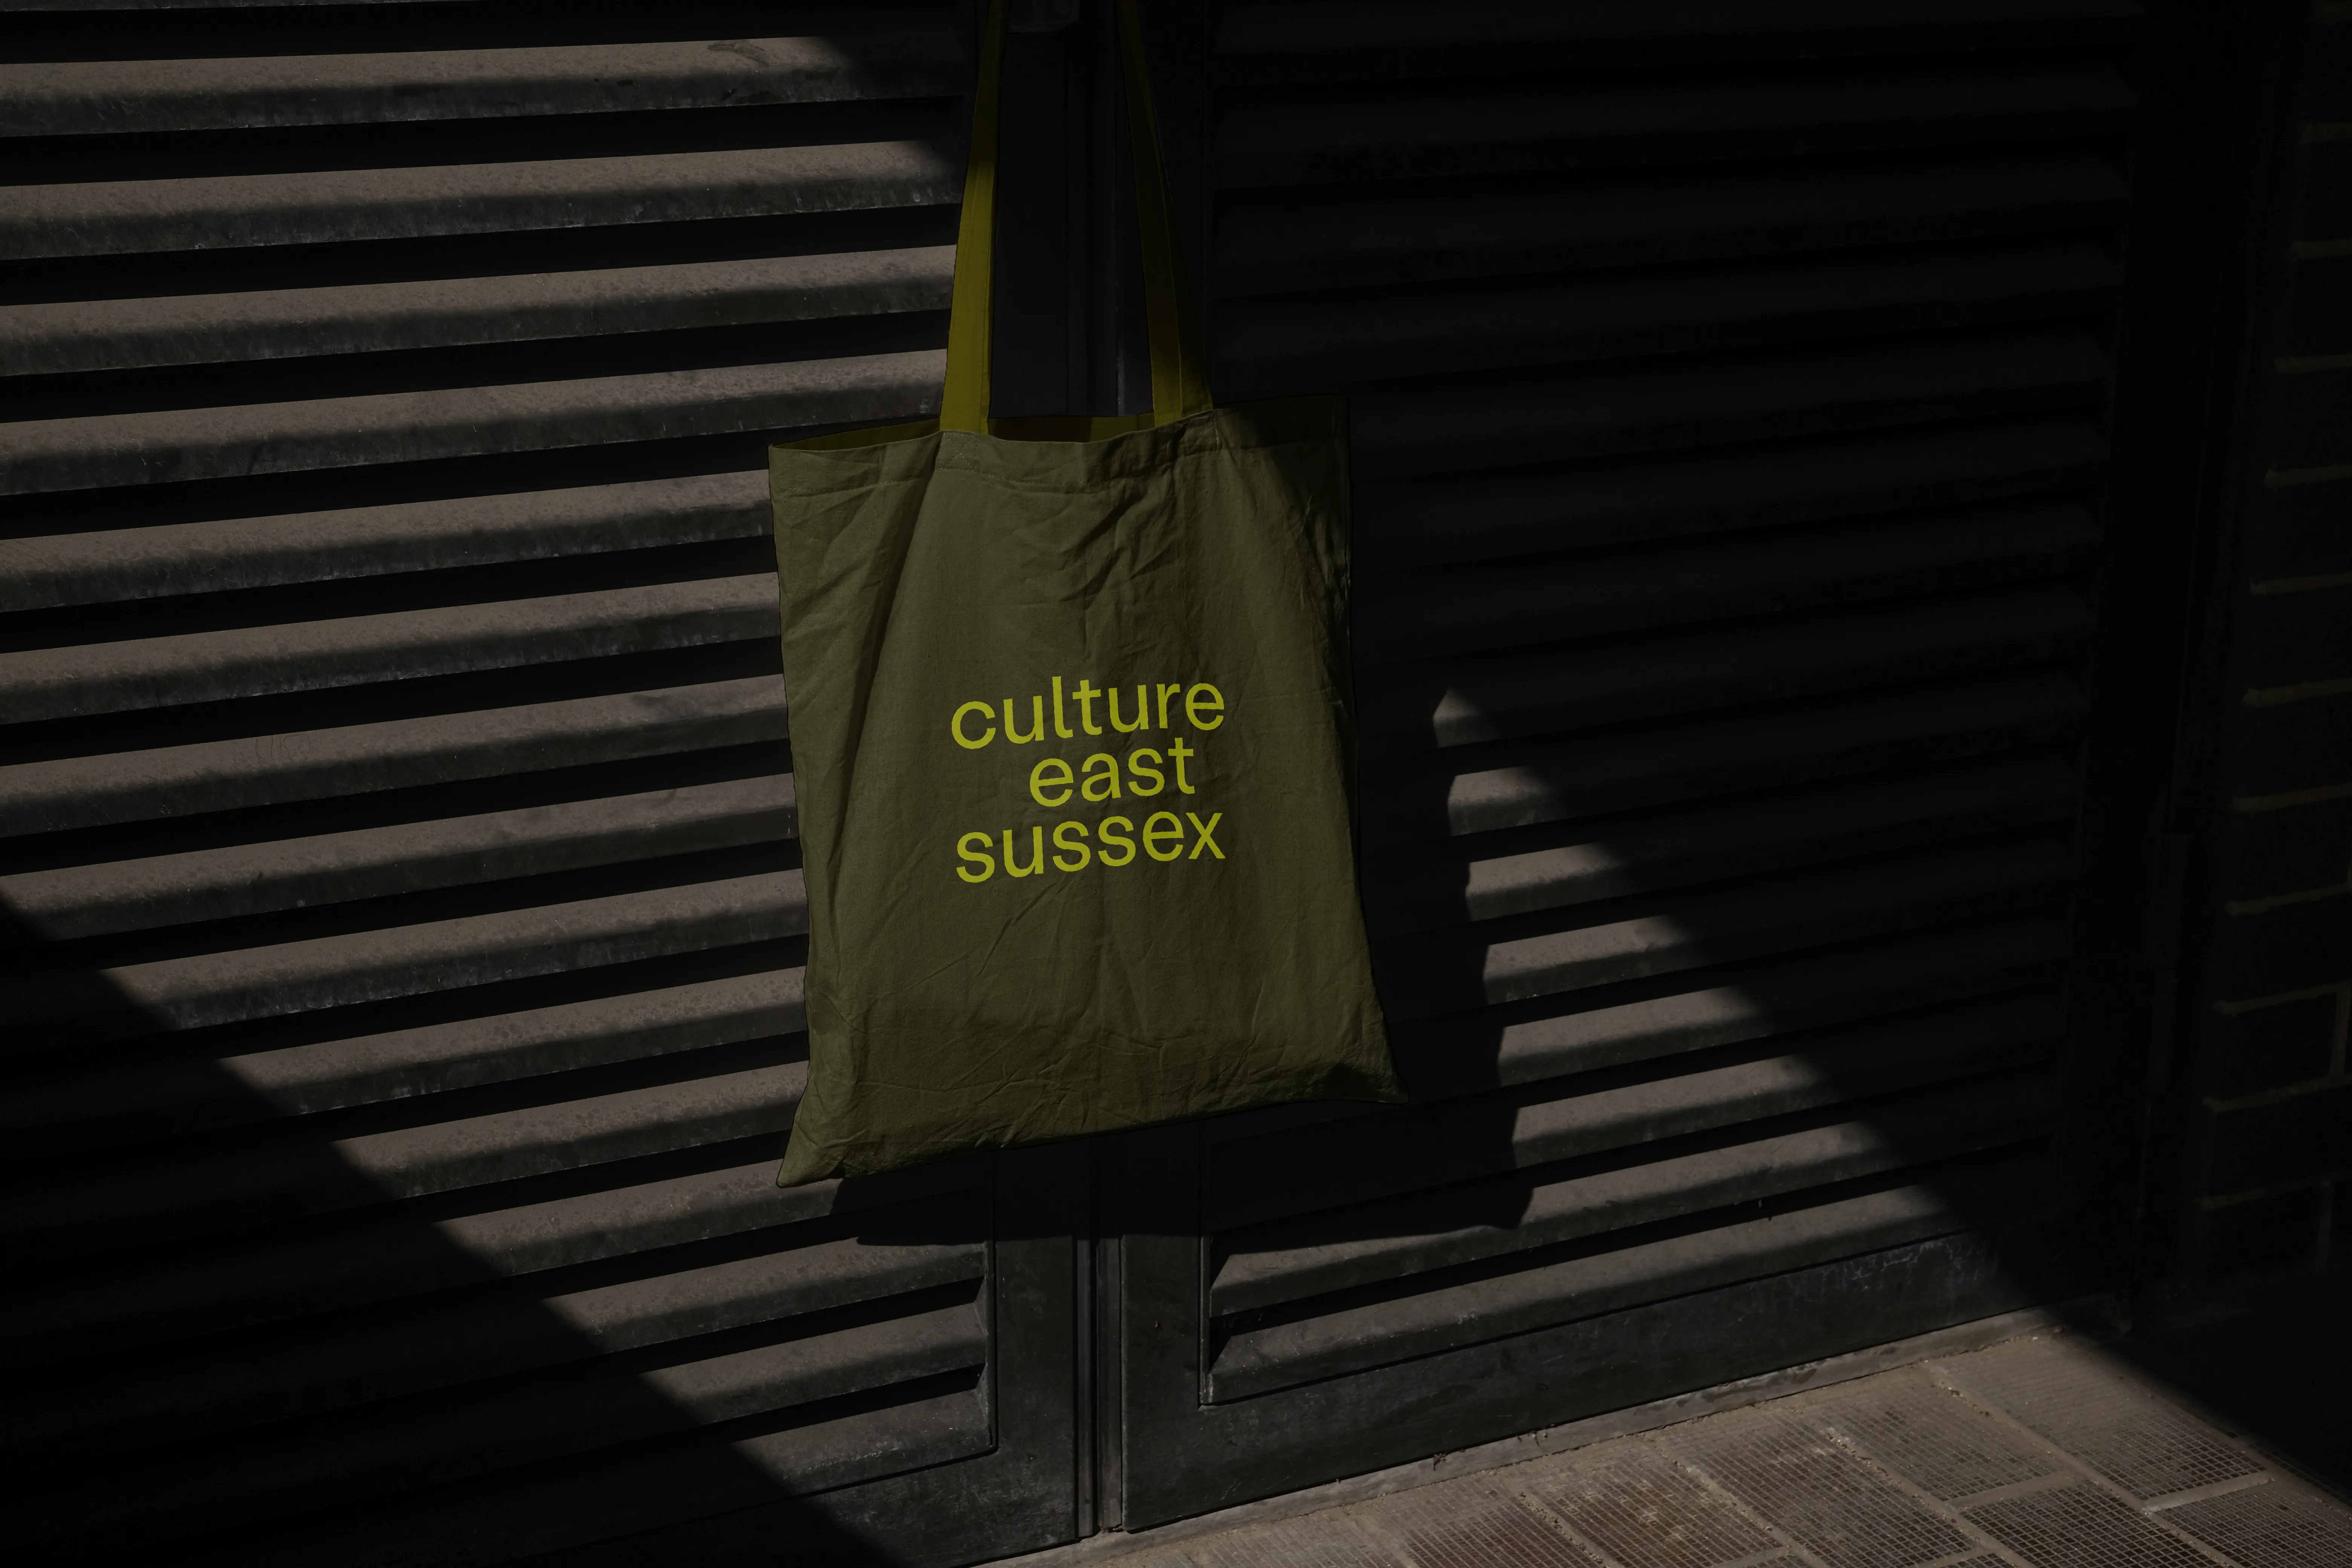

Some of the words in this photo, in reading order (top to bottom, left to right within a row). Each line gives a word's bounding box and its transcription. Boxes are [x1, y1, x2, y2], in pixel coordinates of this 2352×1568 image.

[951, 676, 1225, 749] culture
[1030, 738, 1195, 807] east
[956, 811, 1225, 883] sussex
